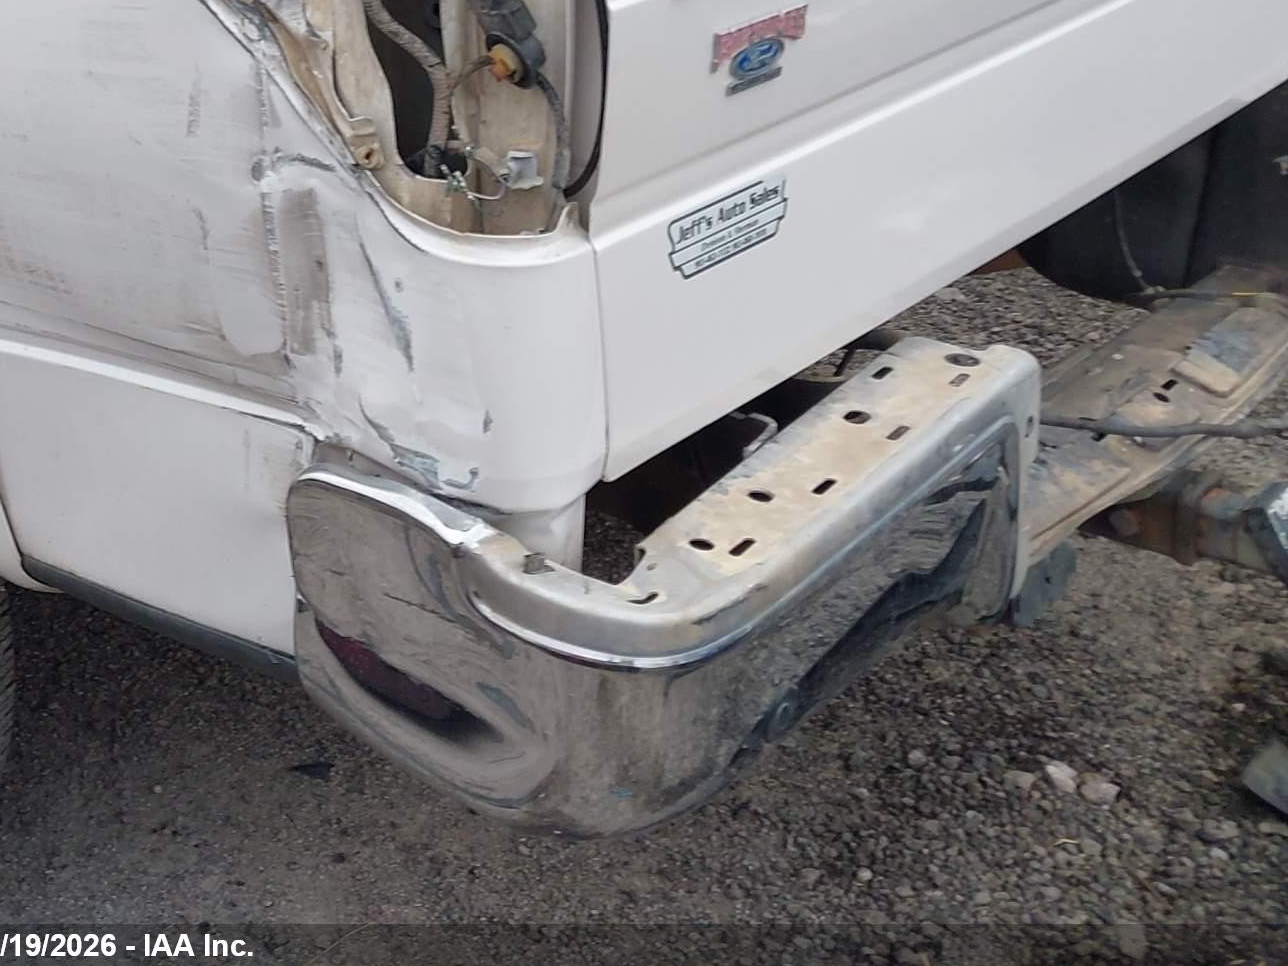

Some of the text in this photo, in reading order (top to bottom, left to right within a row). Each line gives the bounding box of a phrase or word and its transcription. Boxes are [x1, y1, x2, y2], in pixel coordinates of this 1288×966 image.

[676, 215, 713, 245] Jeff's
[717, 201, 746, 223] Auto
[749, 186, 780, 210] Sales
